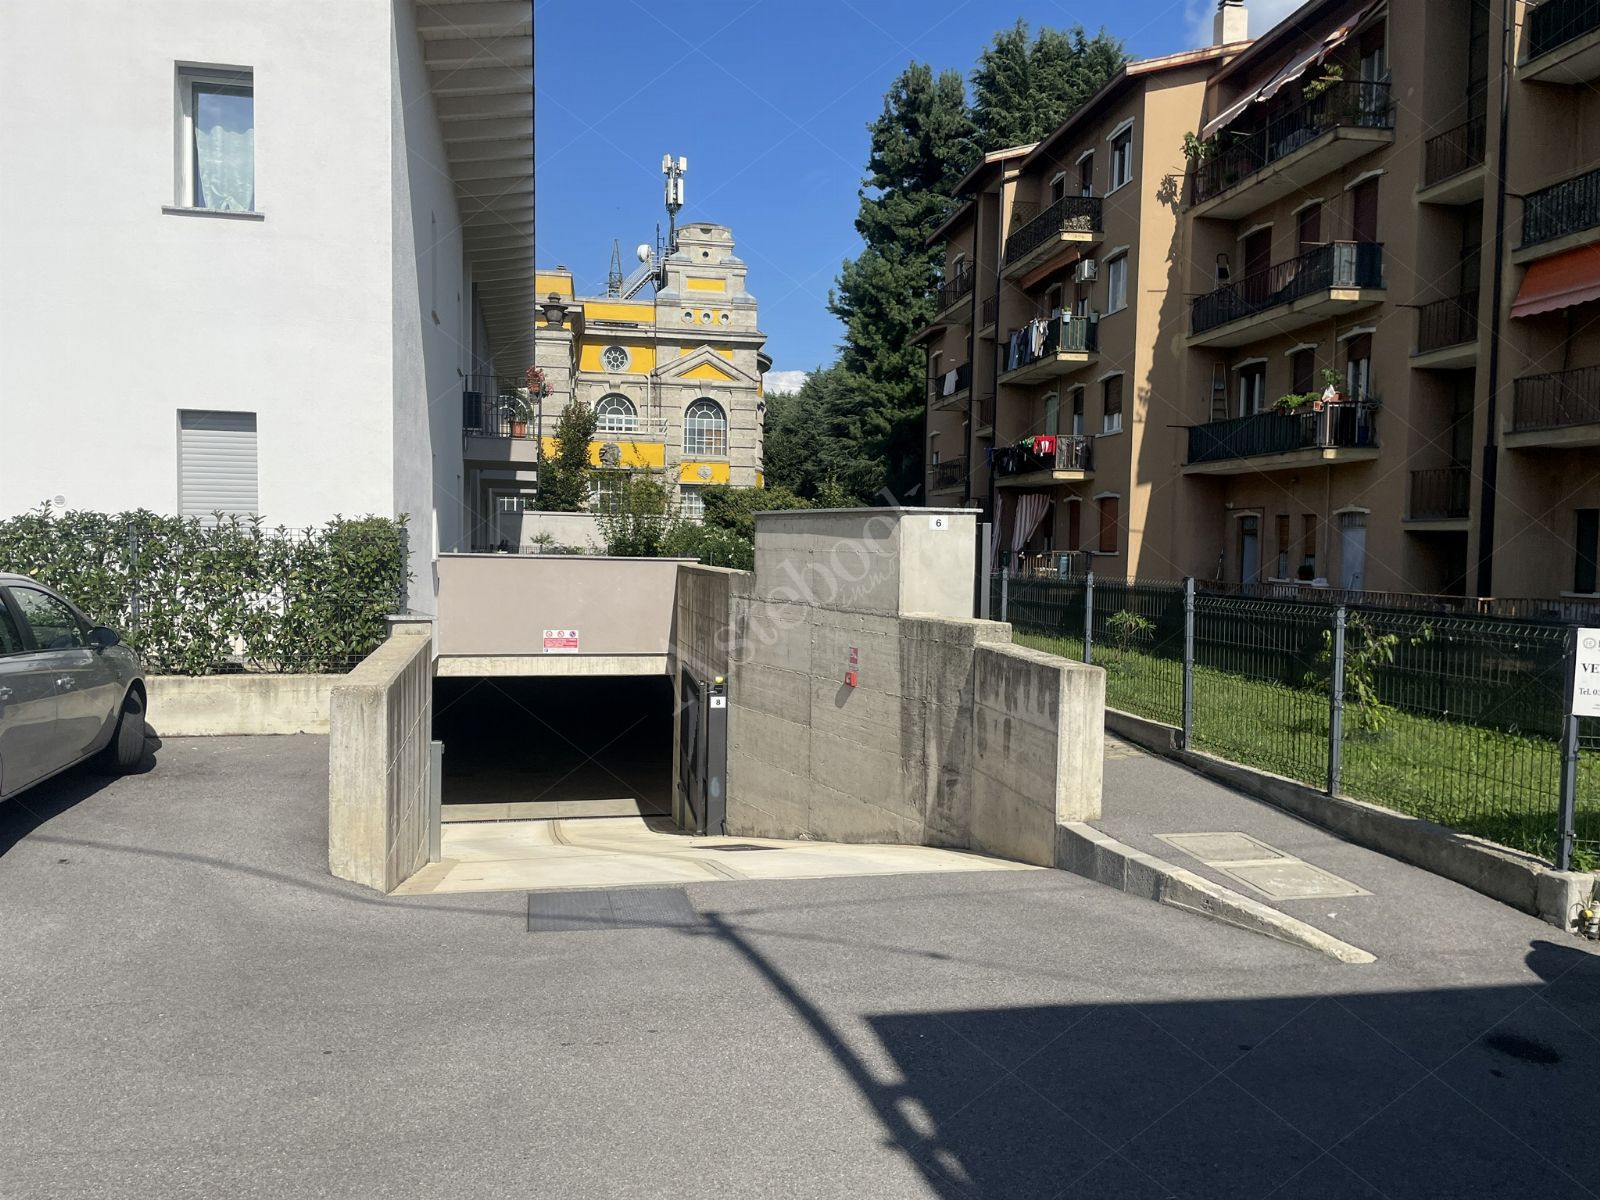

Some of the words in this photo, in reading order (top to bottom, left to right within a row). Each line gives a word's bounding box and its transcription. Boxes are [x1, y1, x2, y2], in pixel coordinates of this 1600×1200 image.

[935, 518, 942, 528] 6
[1581, 663, 1600, 673] VE
[715, 698, 722, 706] 8
